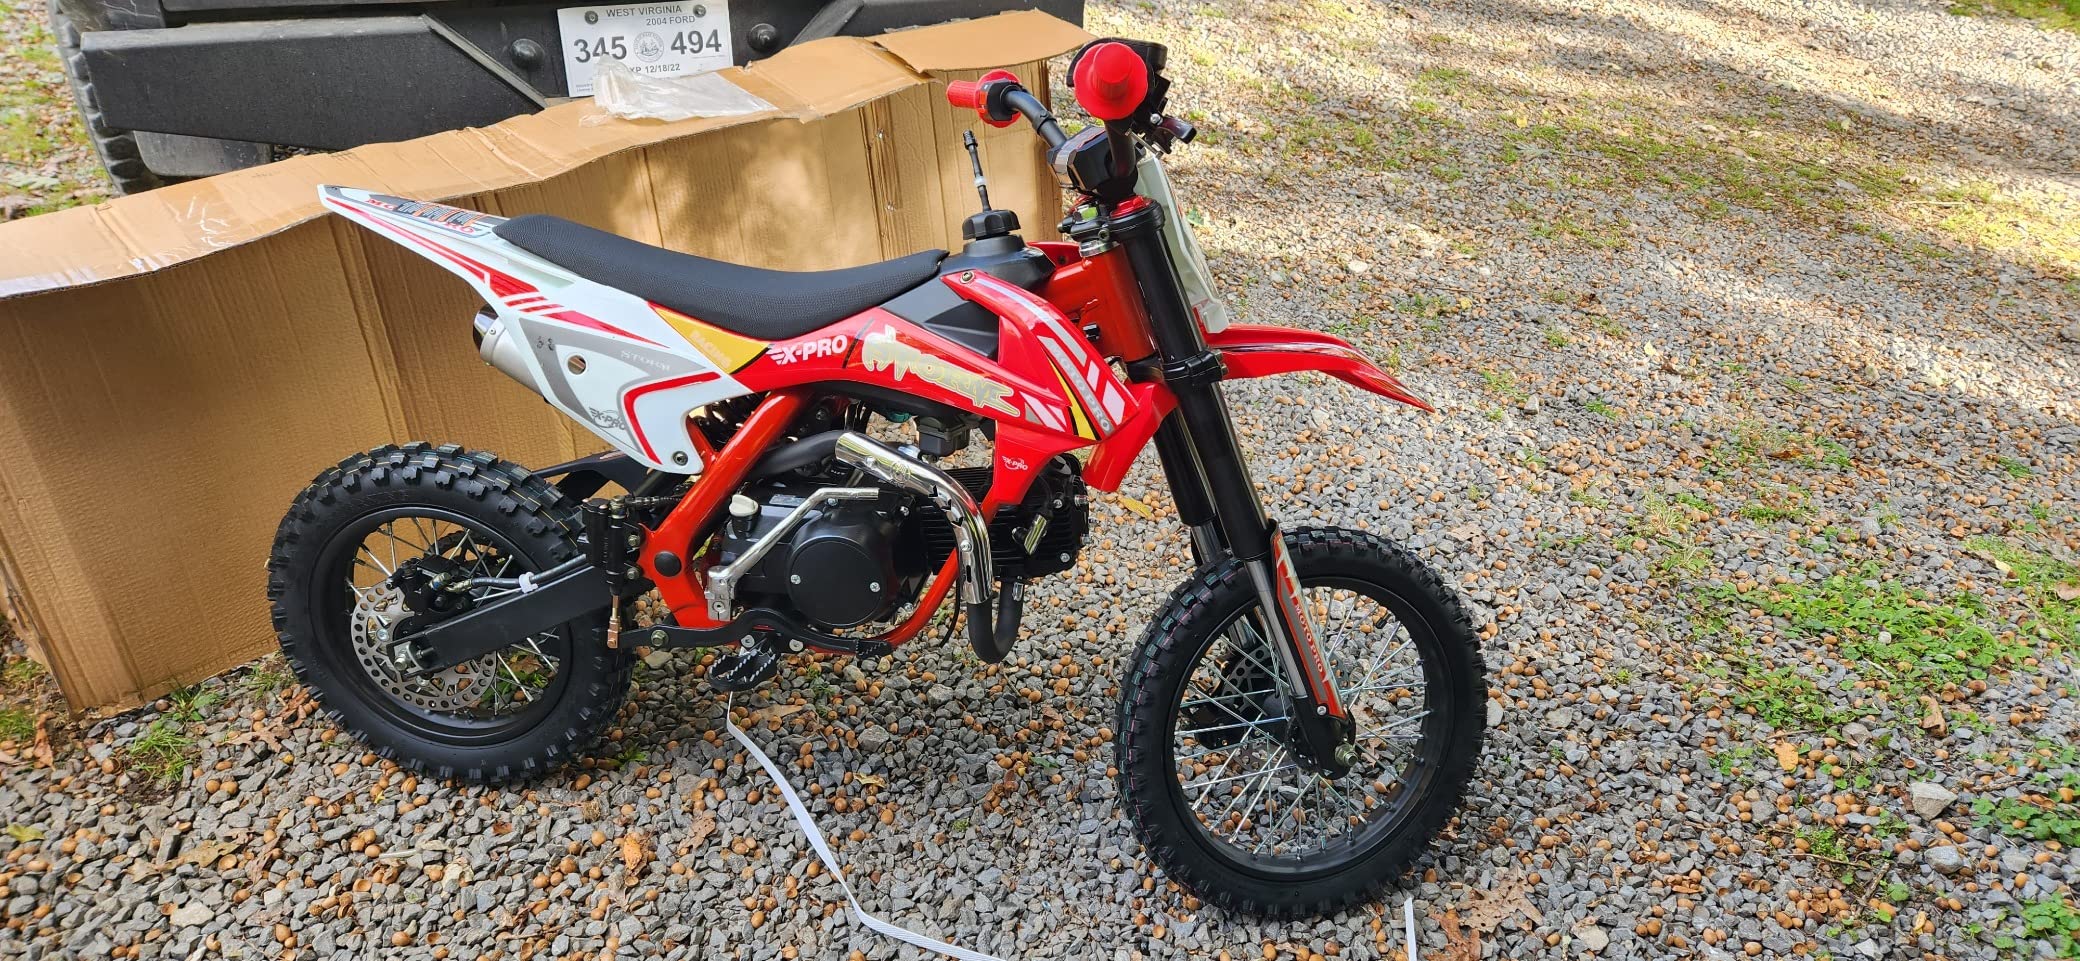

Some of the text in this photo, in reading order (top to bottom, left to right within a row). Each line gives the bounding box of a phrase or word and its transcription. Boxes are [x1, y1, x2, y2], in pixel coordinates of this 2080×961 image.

[606, 5, 682, 17] WEST VIRGINIA
[646, 15, 695, 26] 2004 FORD
[573, 36, 627, 63] 345
[670, 29, 722, 55] 494
[645, 63, 680, 73] 12/18/22
[780, 334, 848, 365] X-PRO
